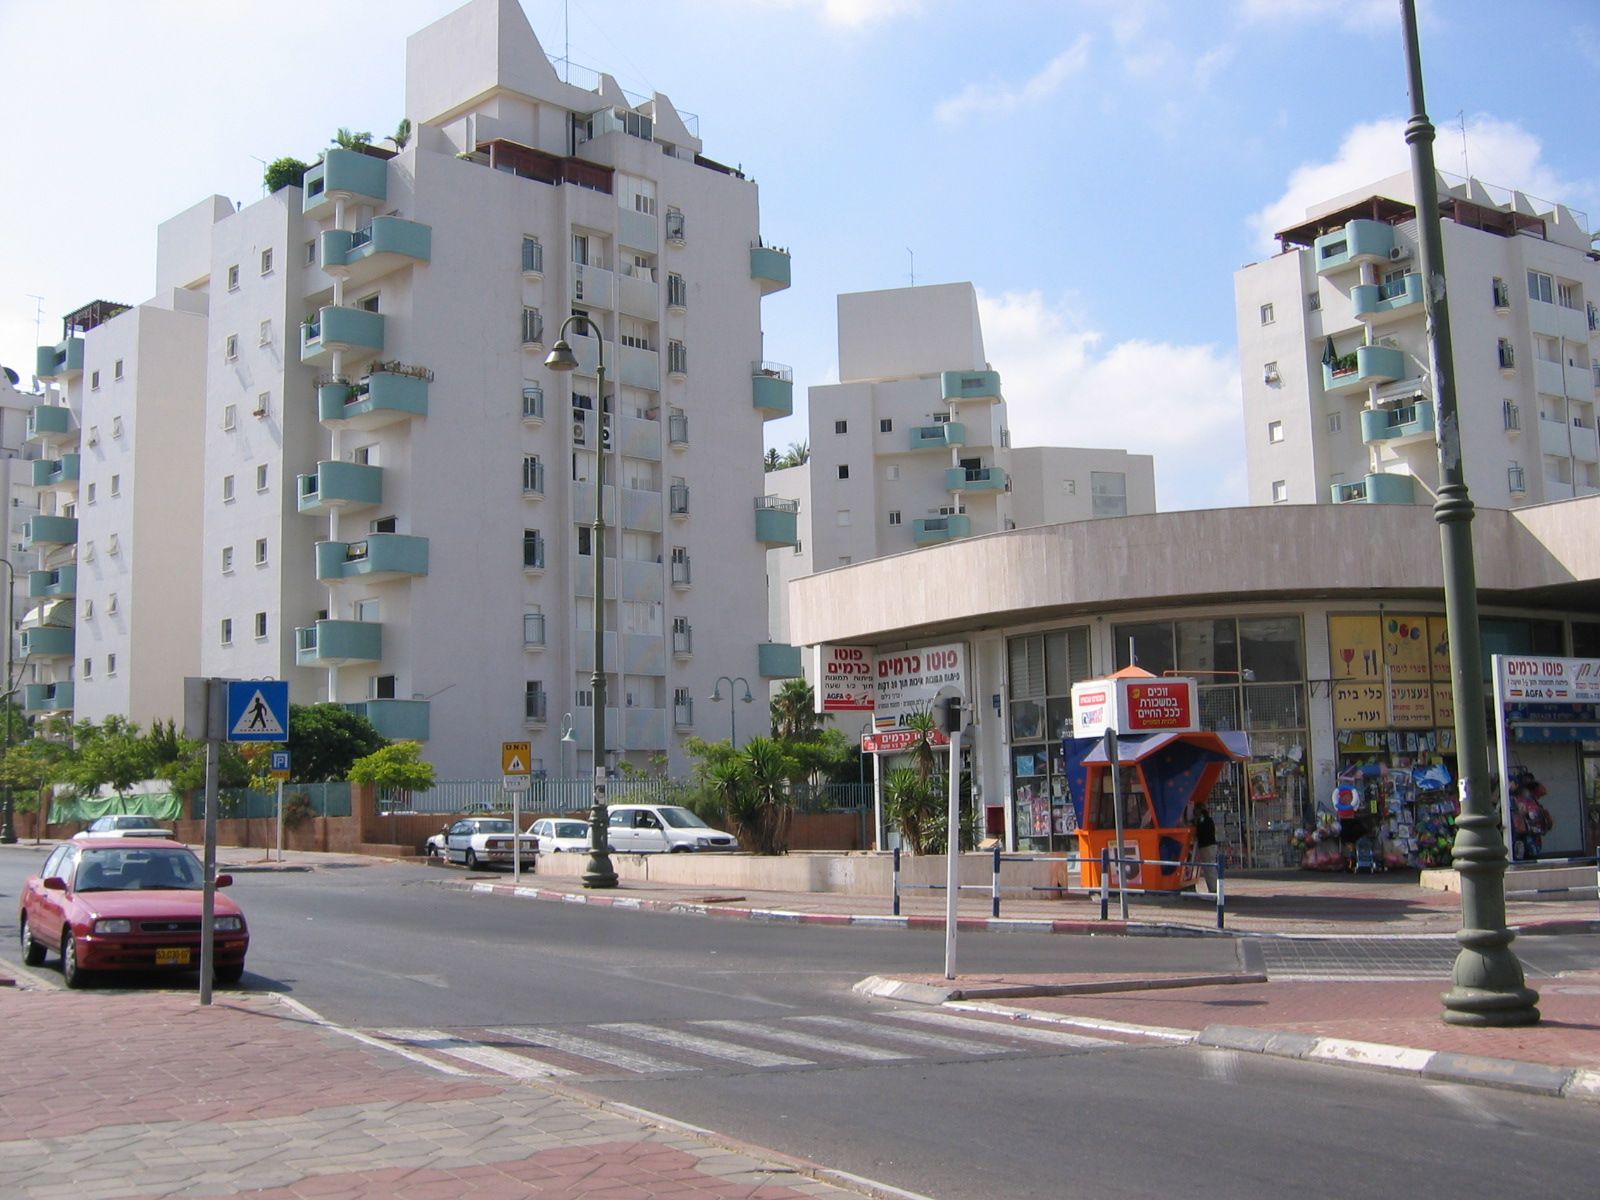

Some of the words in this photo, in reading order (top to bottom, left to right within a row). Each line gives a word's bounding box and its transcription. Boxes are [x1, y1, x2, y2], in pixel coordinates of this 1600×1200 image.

[834, 648, 863, 660] פוטו
[878, 655, 921, 677] כרמים
[926, 650, 958, 671] פוטו
[827, 662, 870, 674] כרמים
[1508, 661, 1538, 676] כרמים
[1542, 662, 1563, 676] פוטו
[1147, 687, 1168, 697] זוכים
[1338, 690, 1359, 700] בית
[1364, 688, 1382, 700] כלי
[1391, 688, 1429, 700] צעצועים
[1139, 697, 1178, 708] במשכורת
[881, 733, 911, 743] כרמים
